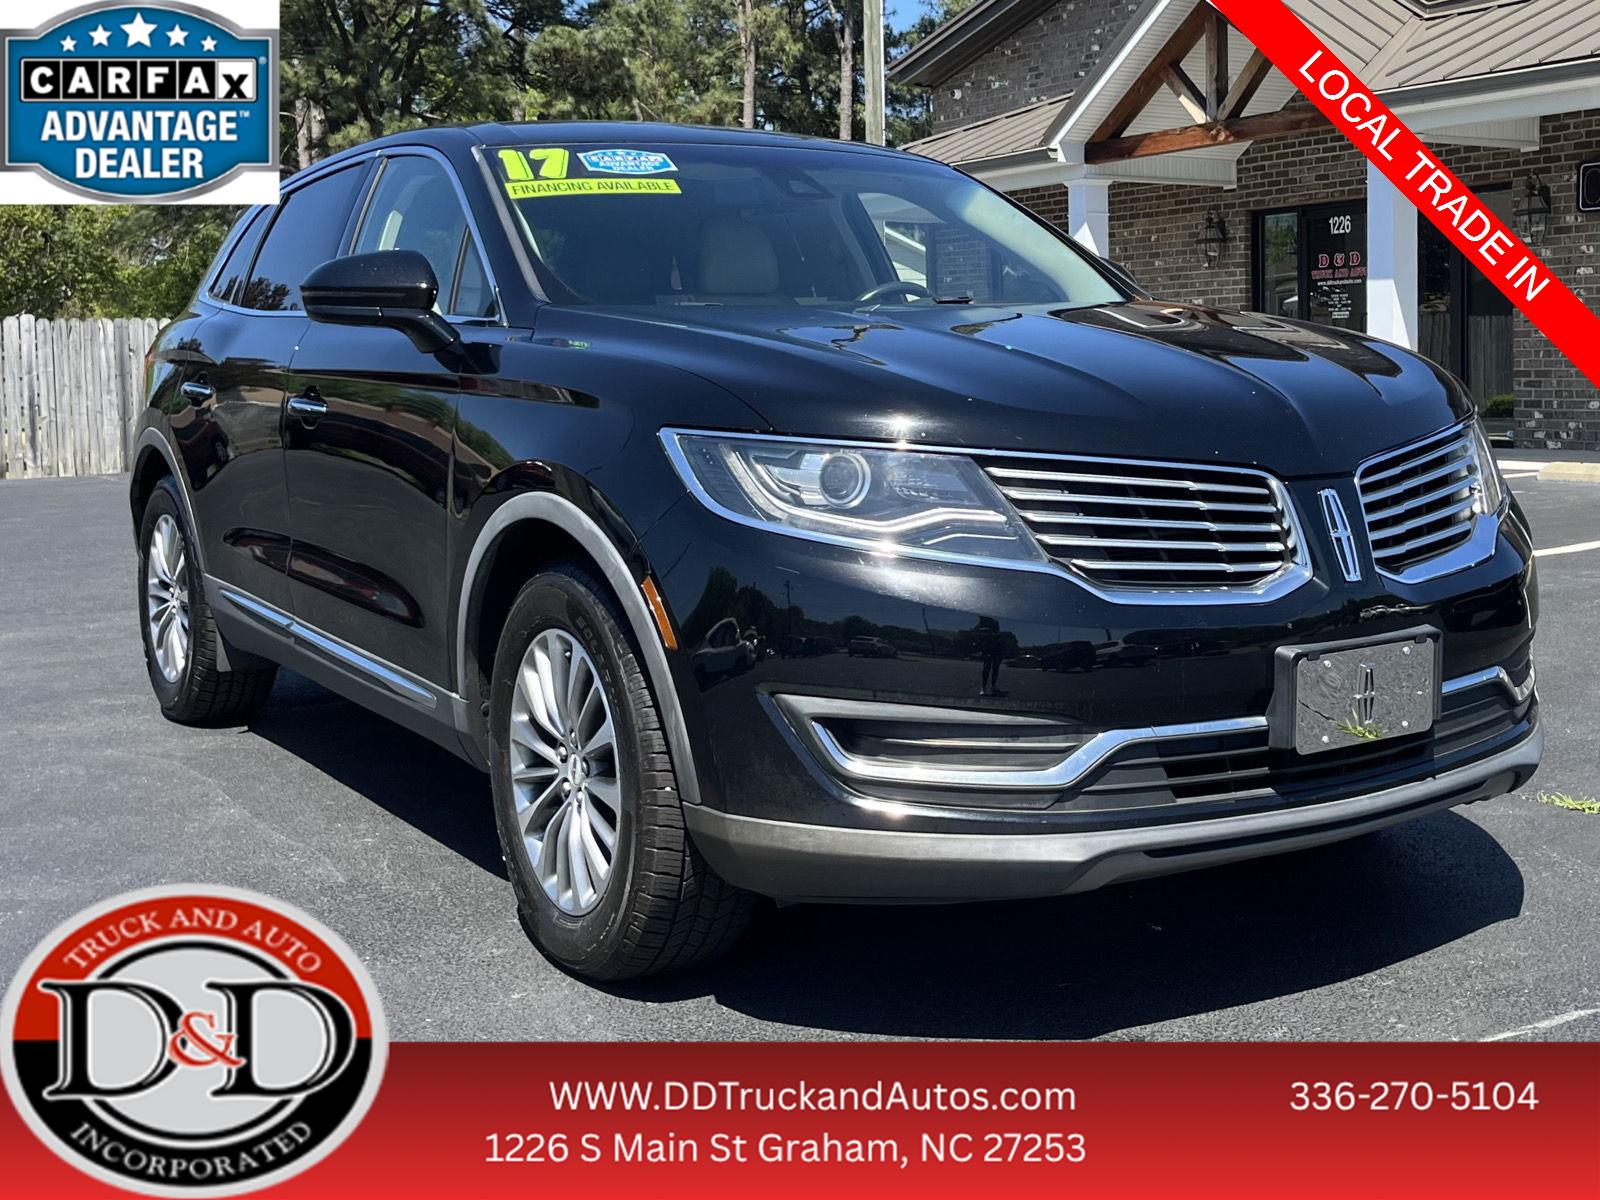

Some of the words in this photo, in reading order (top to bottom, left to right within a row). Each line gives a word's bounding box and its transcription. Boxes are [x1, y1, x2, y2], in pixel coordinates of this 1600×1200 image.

[498, 148, 569, 181] 17
[512, 180, 593, 196] FINANCING
[597, 180, 676, 191] AVAILABLE
[1329, 215, 1352, 235] 1226
[1319, 254, 1329, 268] D
[1349, 251, 1361, 266] D
